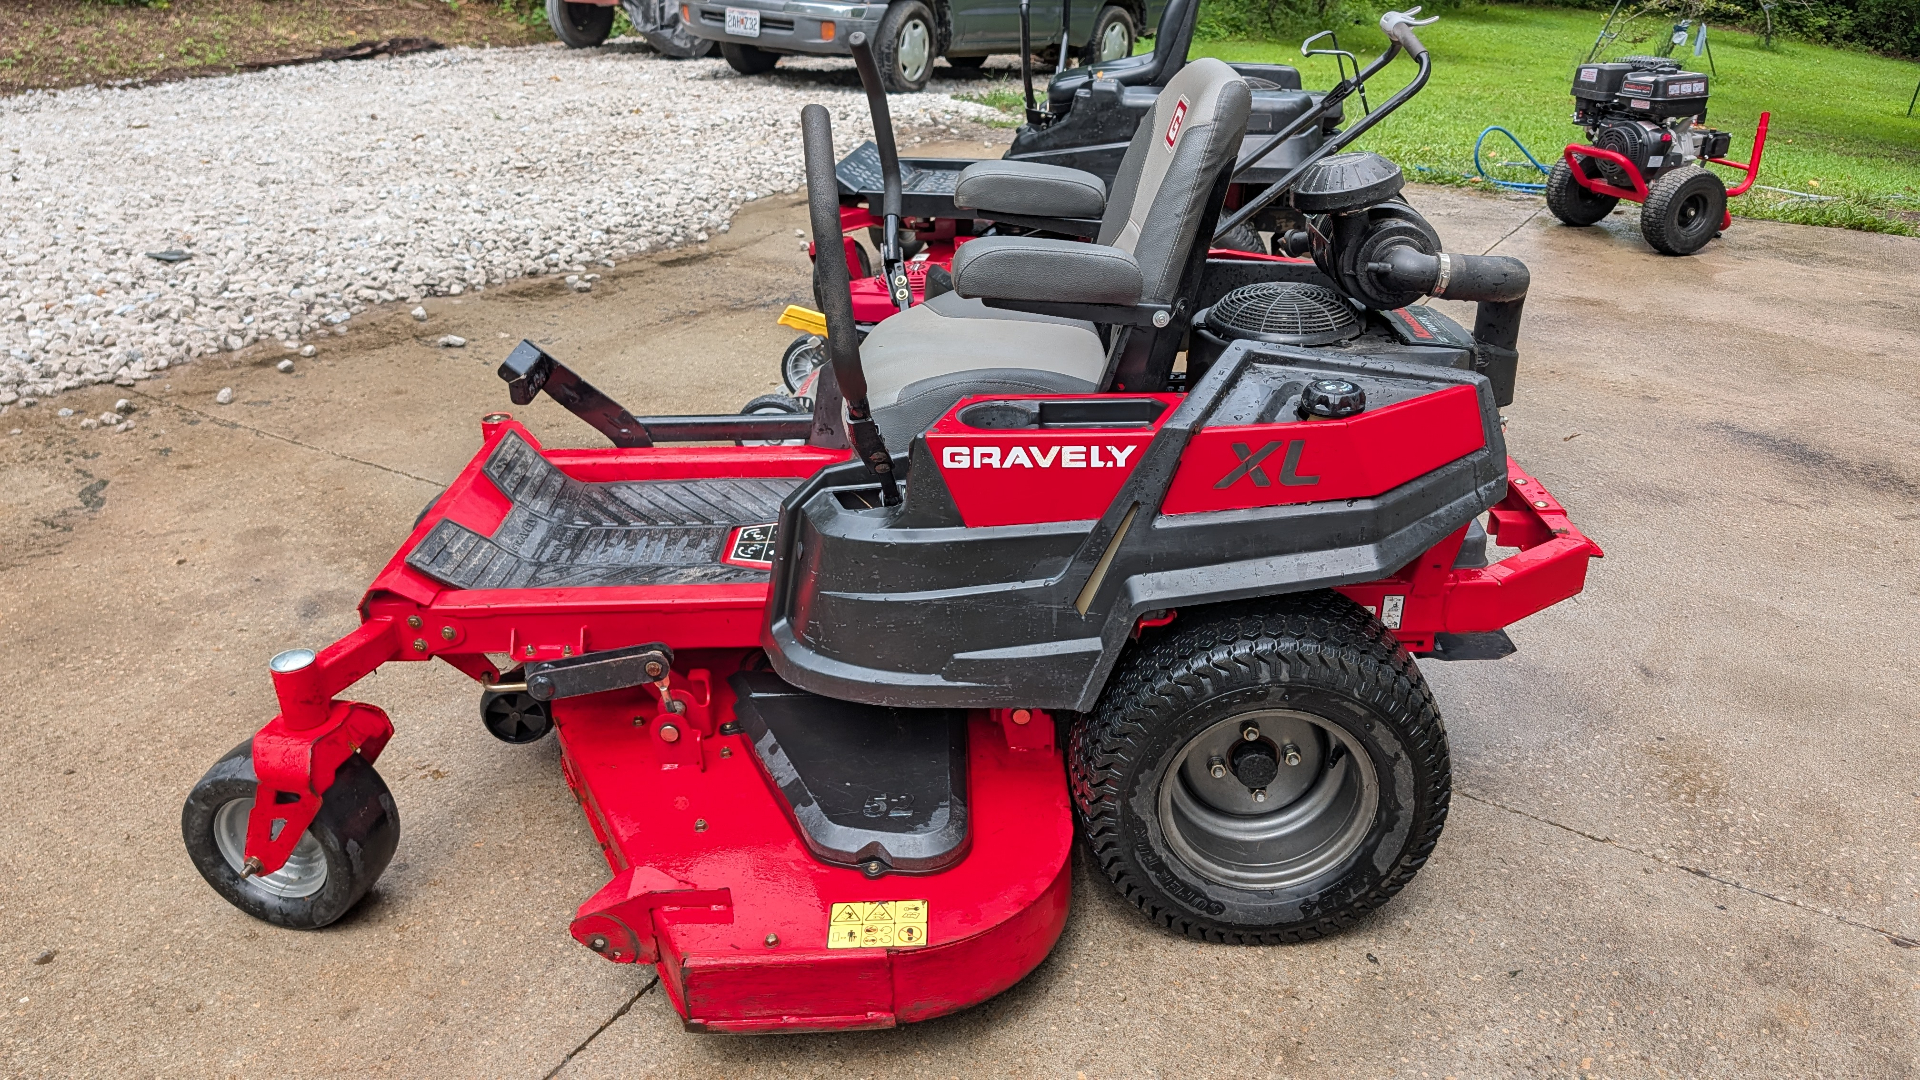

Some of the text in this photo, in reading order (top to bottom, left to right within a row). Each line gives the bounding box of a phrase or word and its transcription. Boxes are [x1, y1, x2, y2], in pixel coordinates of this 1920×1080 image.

[942, 445, 1138, 469] GRAVELY
[1212, 439, 1321, 490] XL
[862, 793, 915, 818] 52
